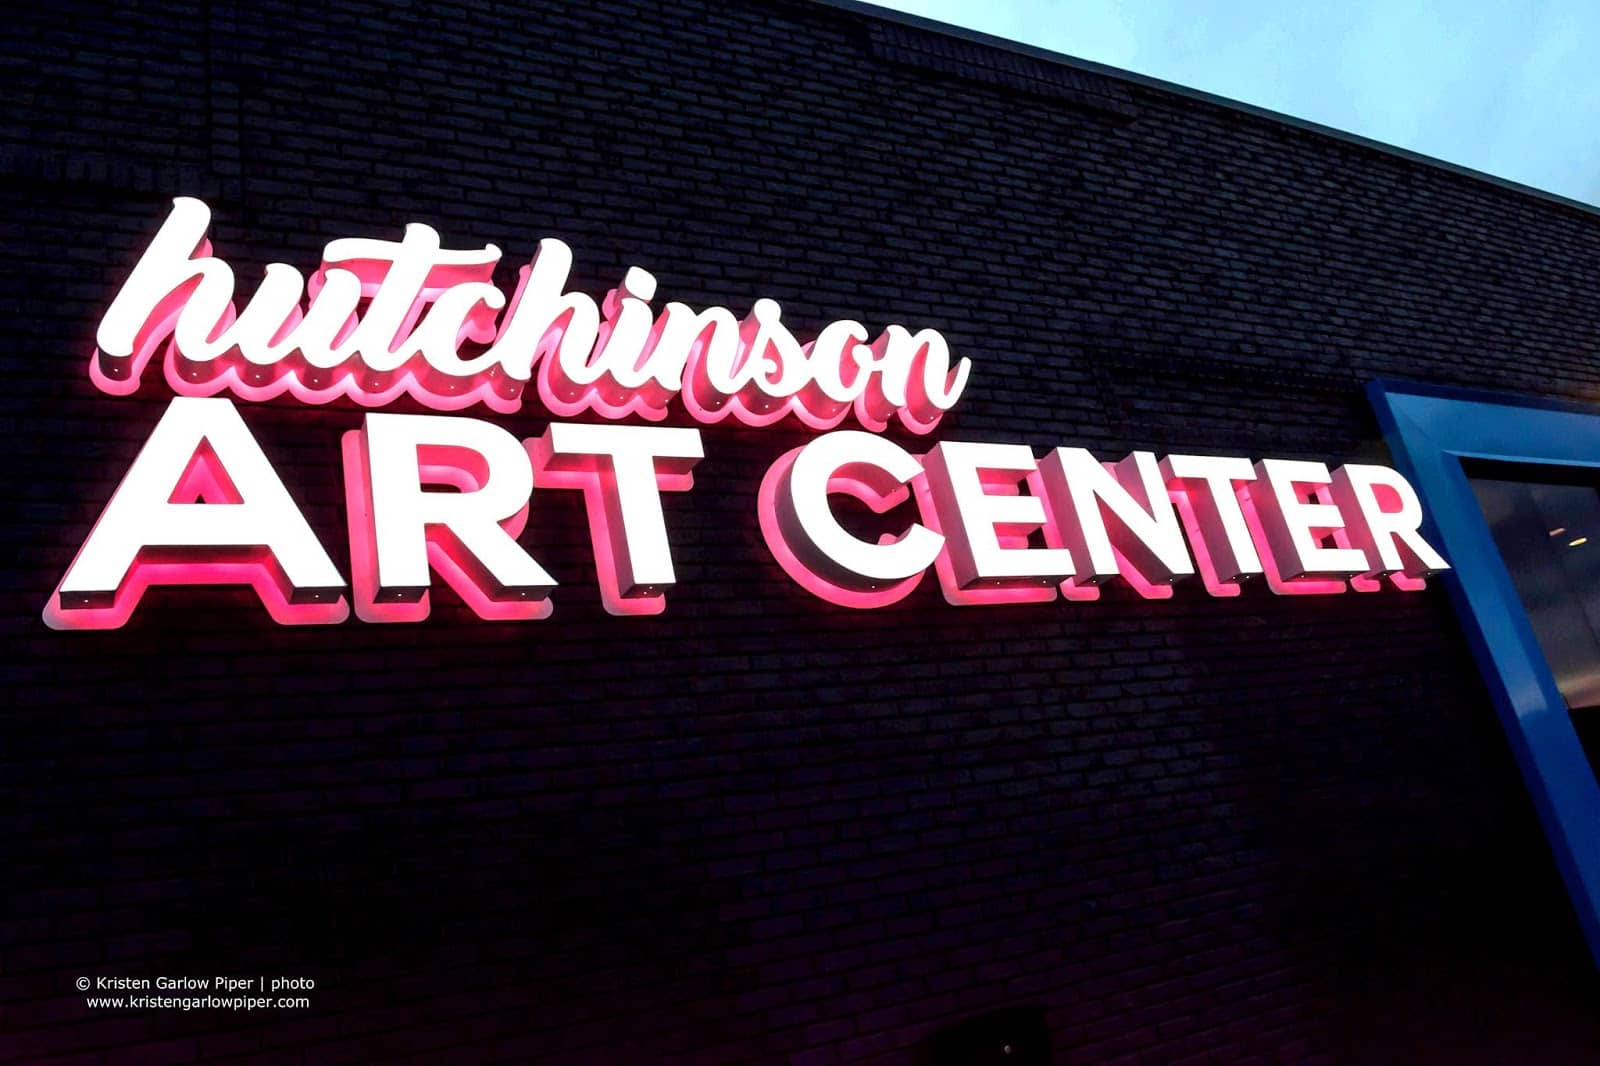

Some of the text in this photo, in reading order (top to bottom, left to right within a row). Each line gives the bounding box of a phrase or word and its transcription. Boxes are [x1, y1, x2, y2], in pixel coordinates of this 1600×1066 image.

[96, 197, 971, 409] hutchinson
[60, 396, 1450, 593] ART CENTER
